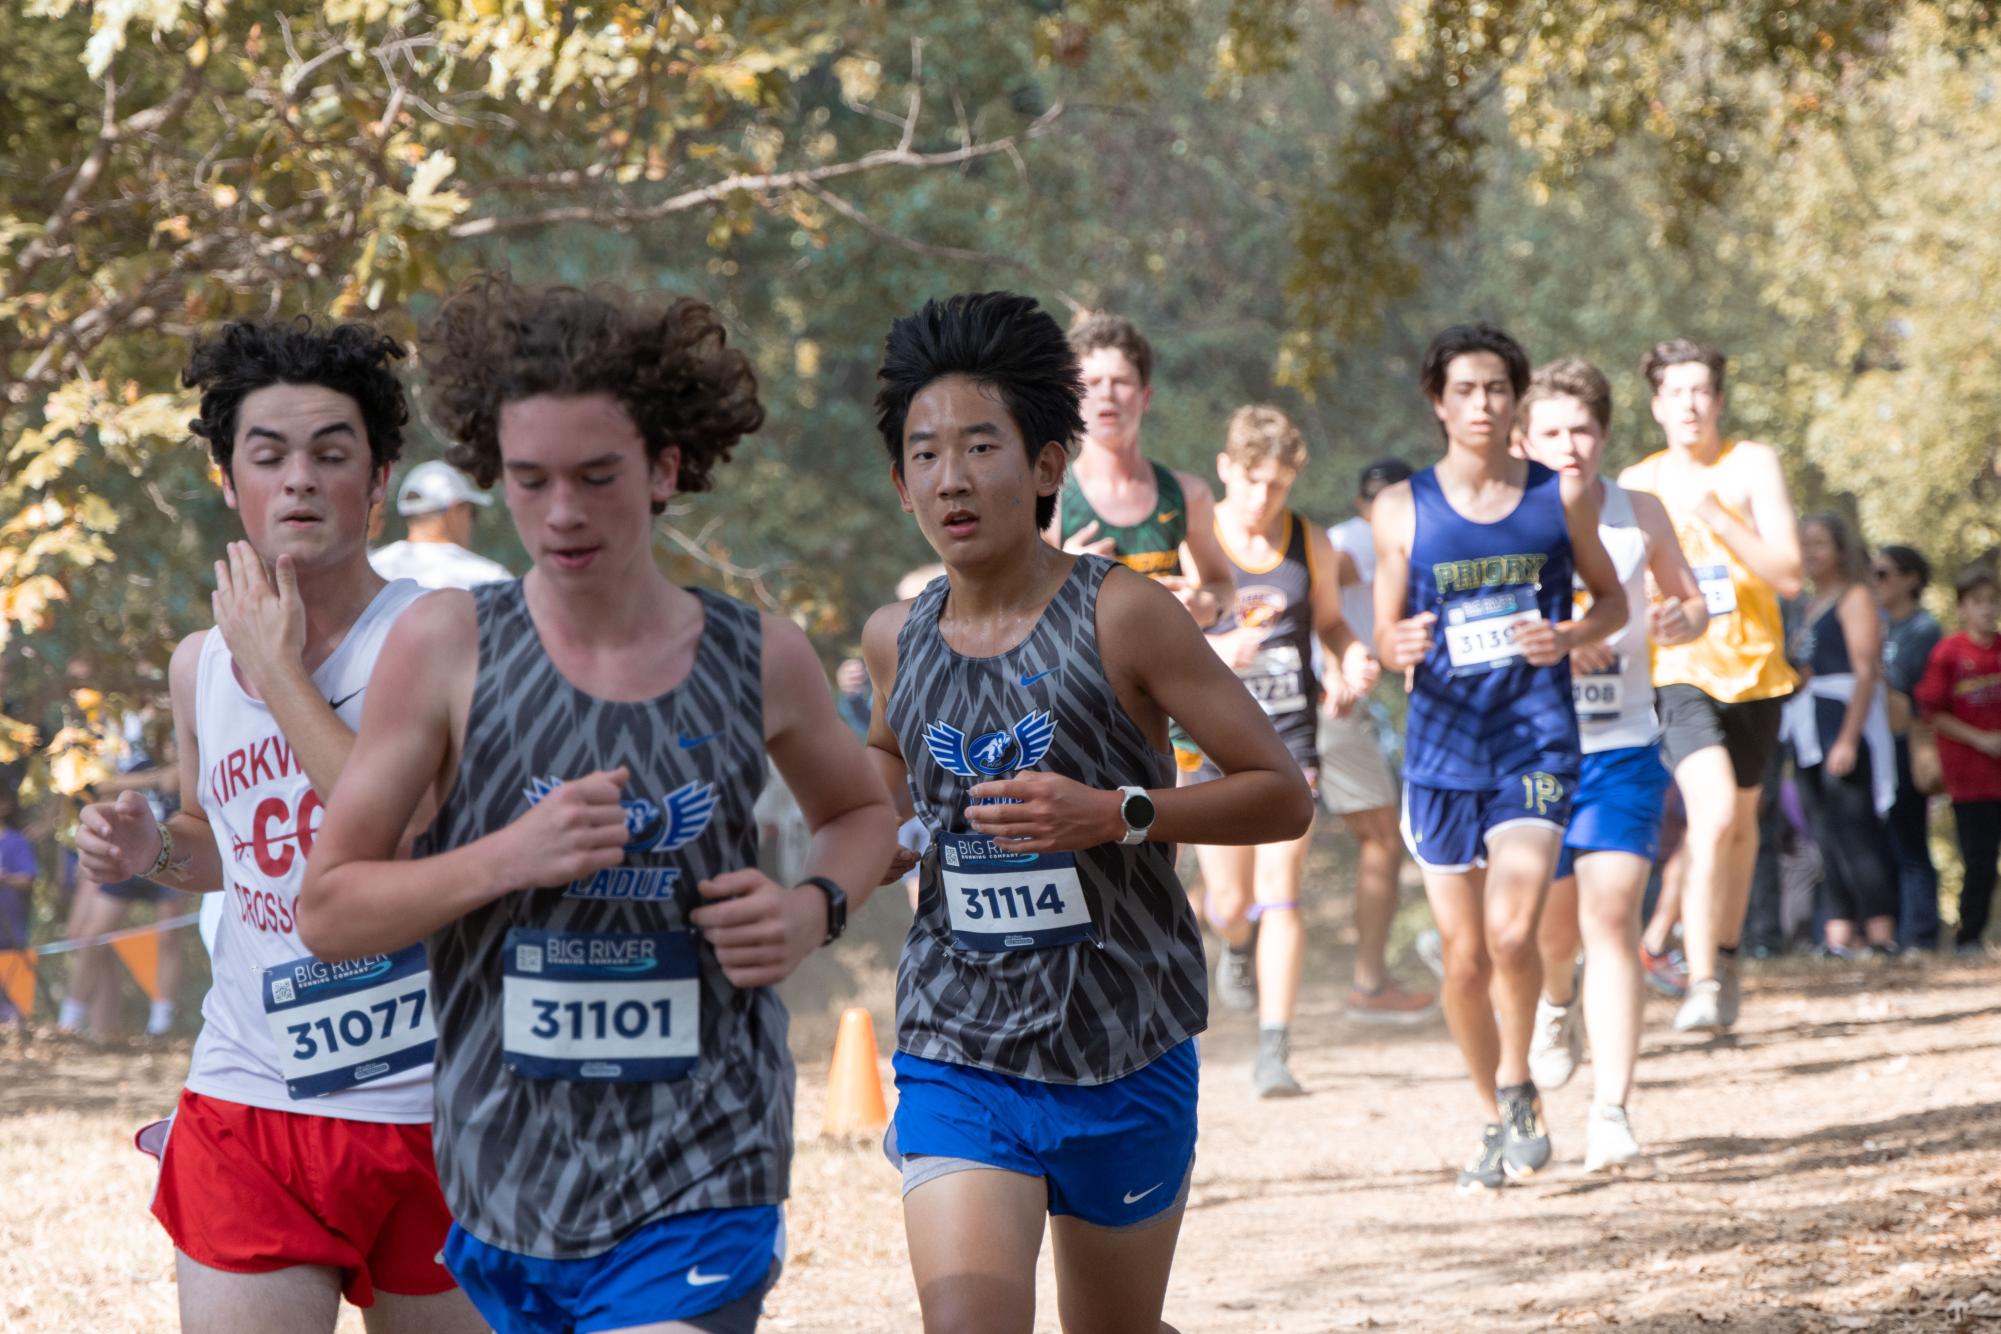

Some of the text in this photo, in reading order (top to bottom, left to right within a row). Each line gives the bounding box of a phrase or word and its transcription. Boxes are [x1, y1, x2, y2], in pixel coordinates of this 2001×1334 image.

[1433, 554, 1547, 594] PRIORY
[958, 840, 984, 855] BIG
[960, 883, 1066, 920] 31114
[547, 939, 656, 959] BIG RIVER
[294, 961, 327, 983] BIG
[287, 989, 427, 1061] 31077
[530, 998, 672, 1040] 31101
